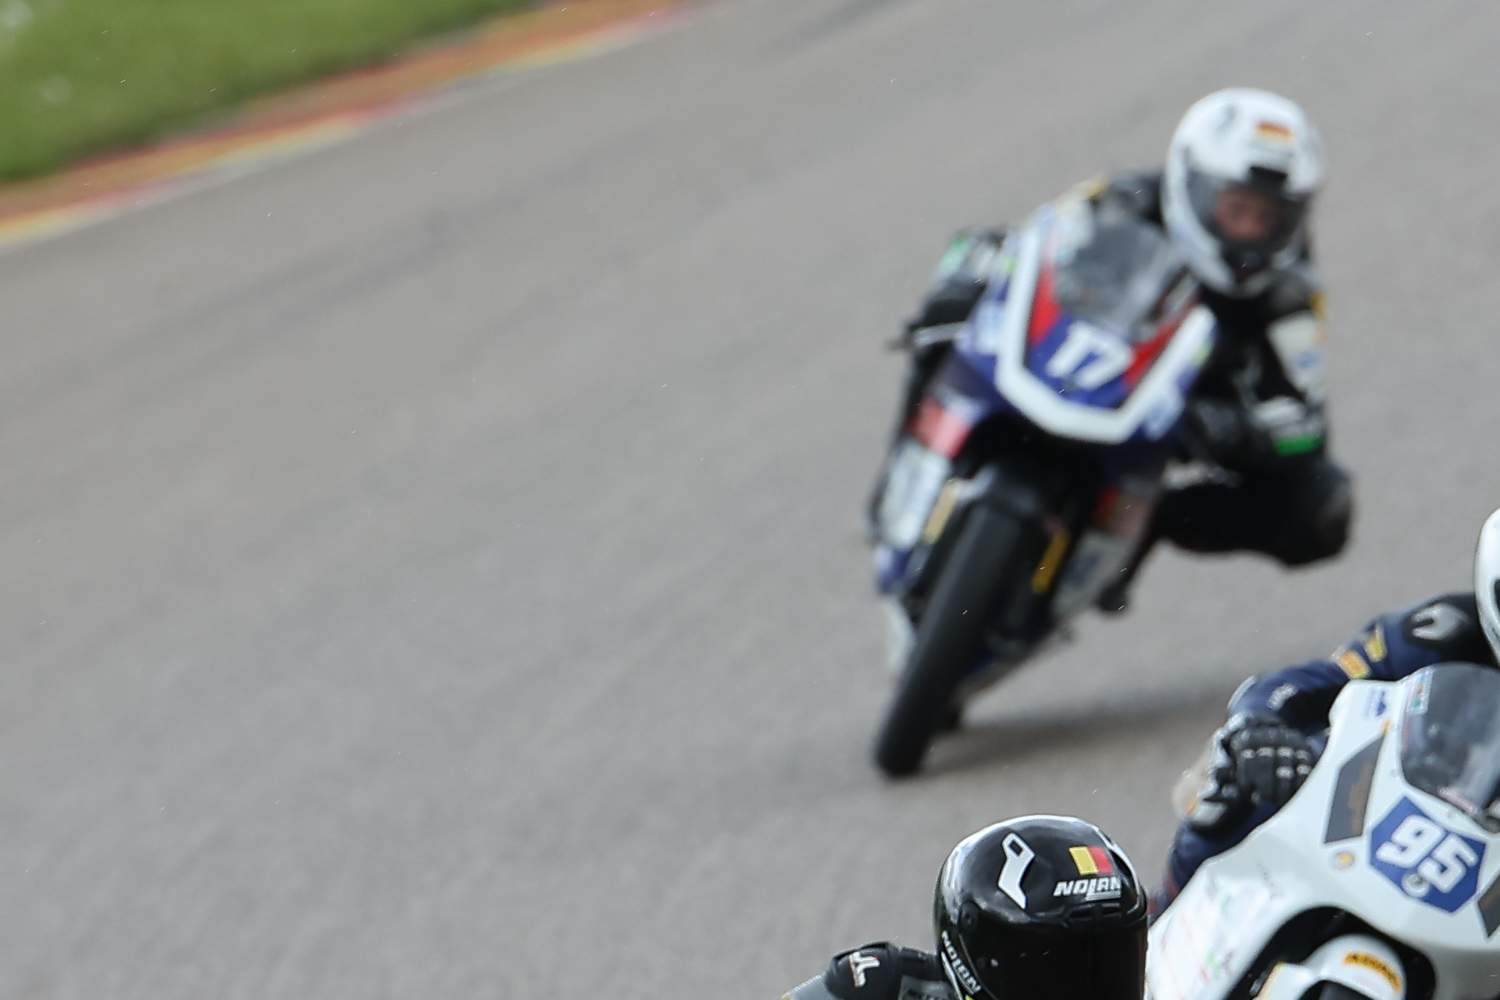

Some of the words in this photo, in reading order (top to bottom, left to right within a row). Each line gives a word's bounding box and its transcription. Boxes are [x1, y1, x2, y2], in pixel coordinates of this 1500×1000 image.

[1045, 320, 1133, 390] 17
[1375, 814, 1479, 894] 95
[1053, 876, 1122, 900] NOLAN
[941, 930, 982, 995] NOLAN
